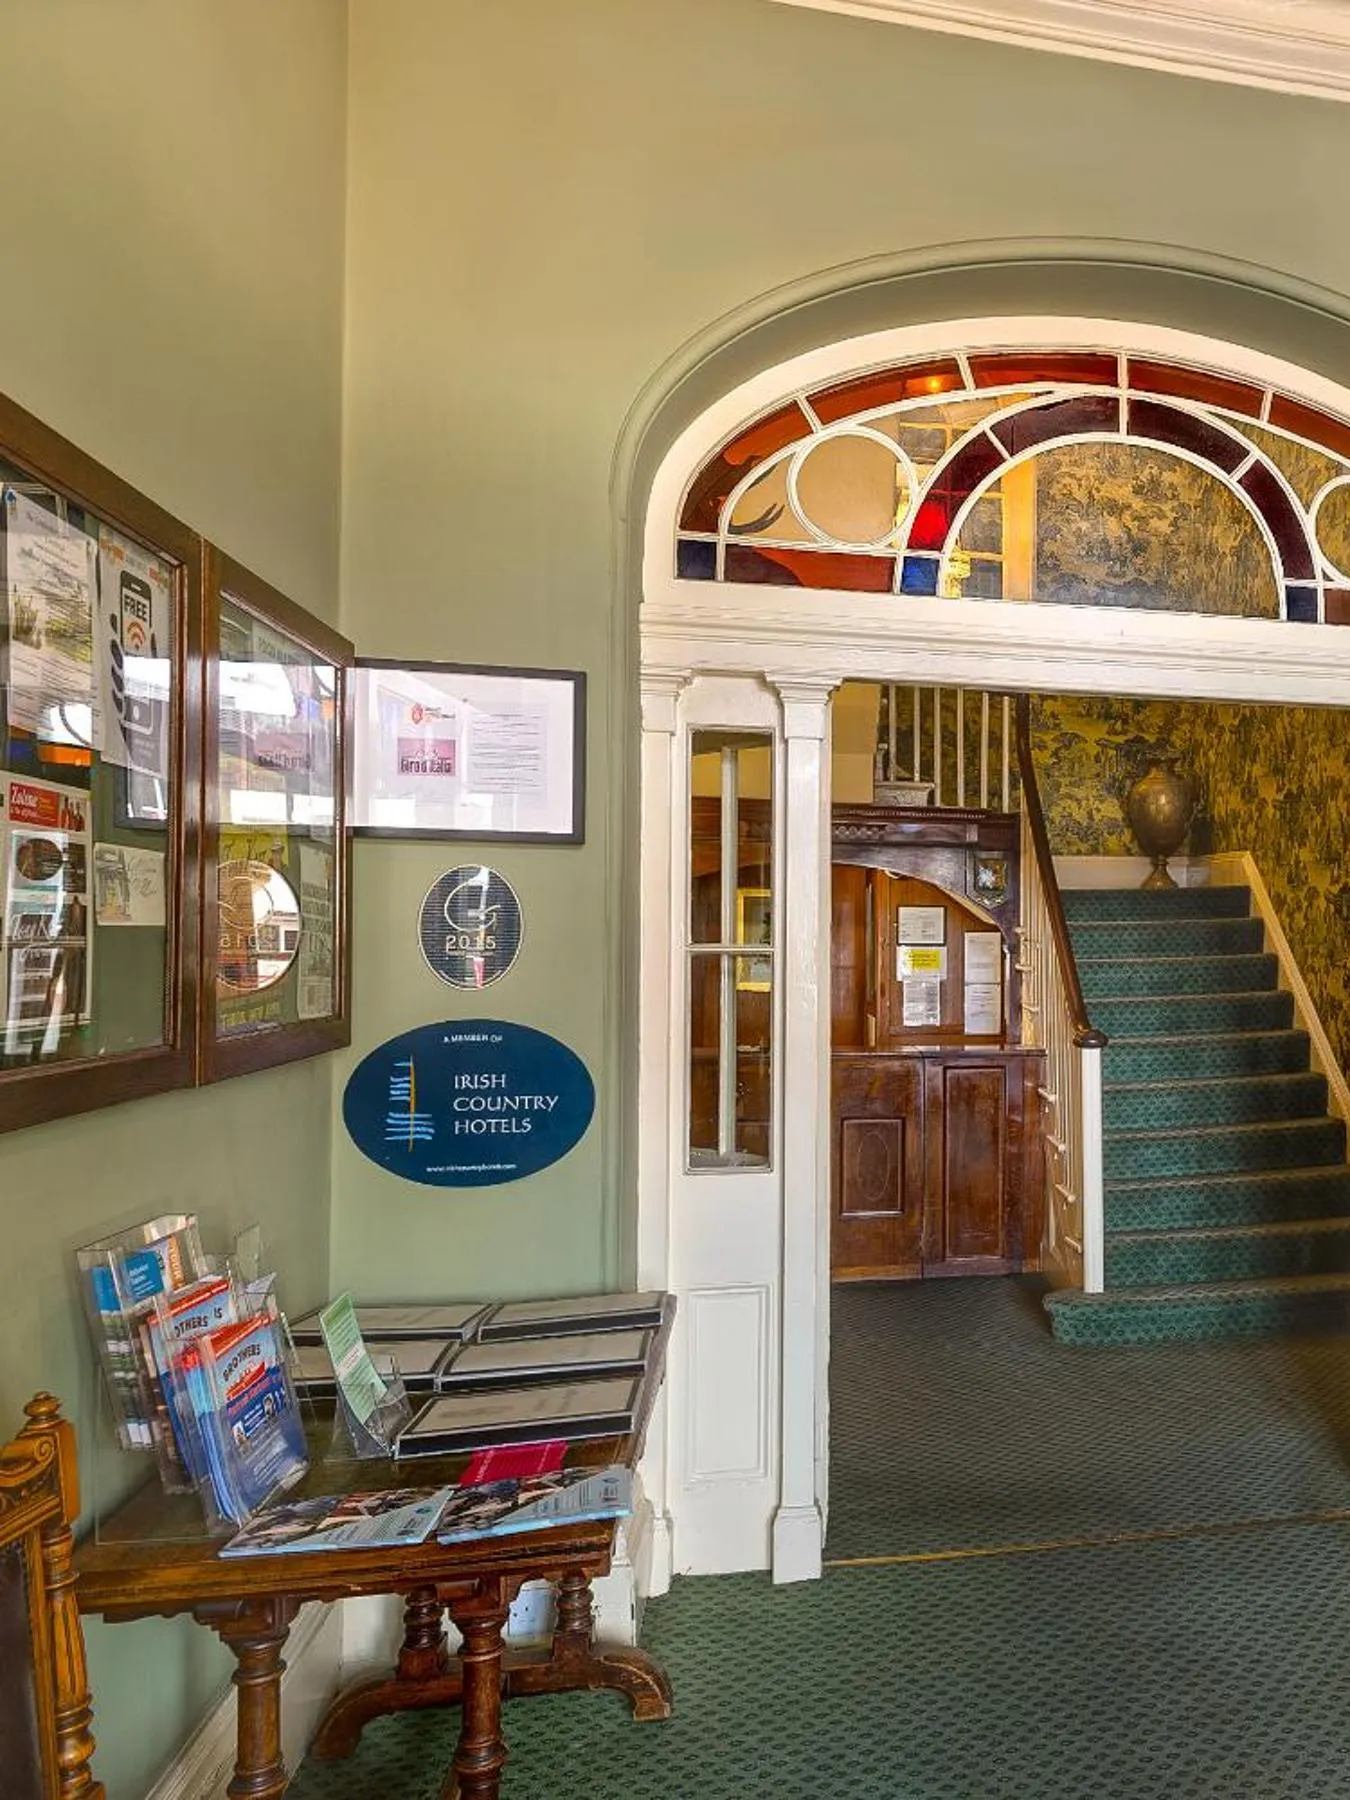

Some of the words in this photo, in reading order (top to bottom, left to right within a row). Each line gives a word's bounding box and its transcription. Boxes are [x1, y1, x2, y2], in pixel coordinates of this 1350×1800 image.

[124, 594, 147, 622] FREE
[445, 934, 496, 950] 2015
[454, 1073, 506, 1090] IRISH
[453, 1095, 559, 1112] COUNTRY
[454, 1117, 532, 1134] HOTELS
